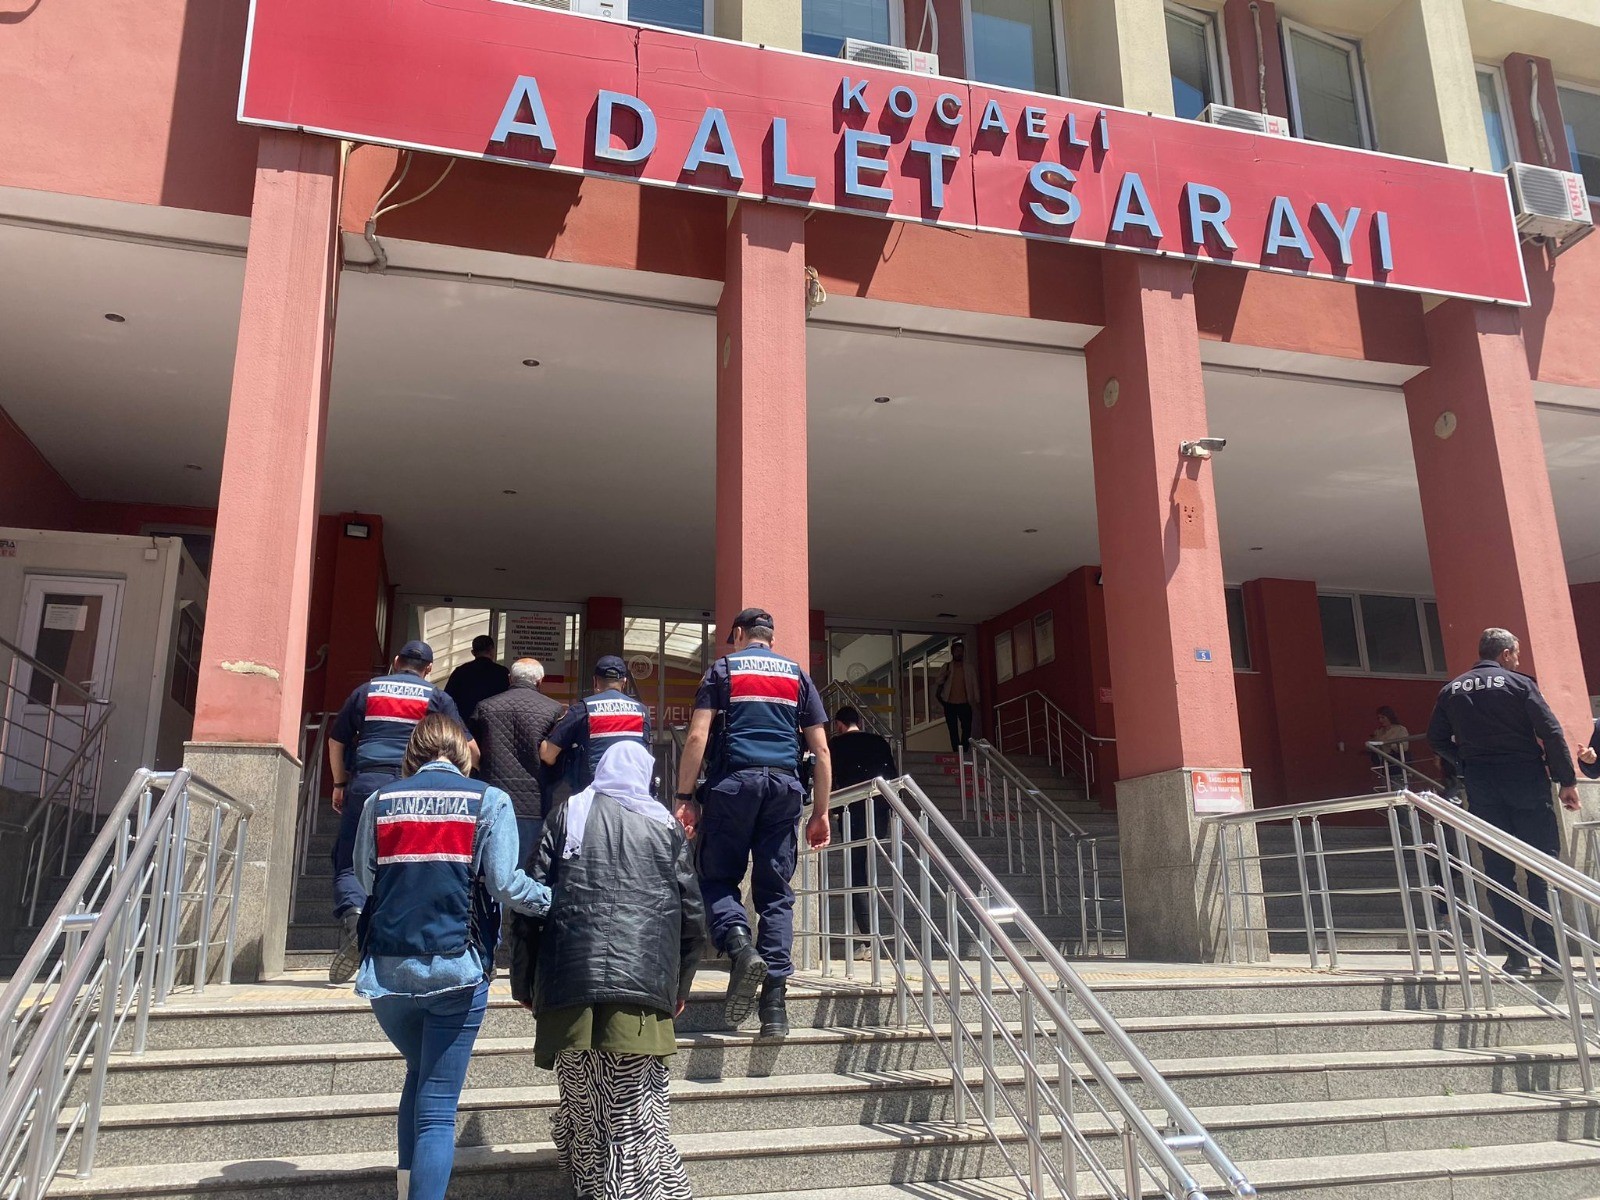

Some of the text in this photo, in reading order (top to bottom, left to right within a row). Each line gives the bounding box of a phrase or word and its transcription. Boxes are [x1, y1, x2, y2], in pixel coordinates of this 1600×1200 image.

[841, 76, 1110, 150] KOCAELİ
[489, 74, 1395, 274] ADALET SARAYI
[1566, 178, 1583, 217] VESTEL
[738, 659, 793, 674] JANDARMA
[375, 684, 425, 697] JANDARMA
[594, 702, 638, 712] JANDARMA
[385, 797, 469, 816] JANDARMA
